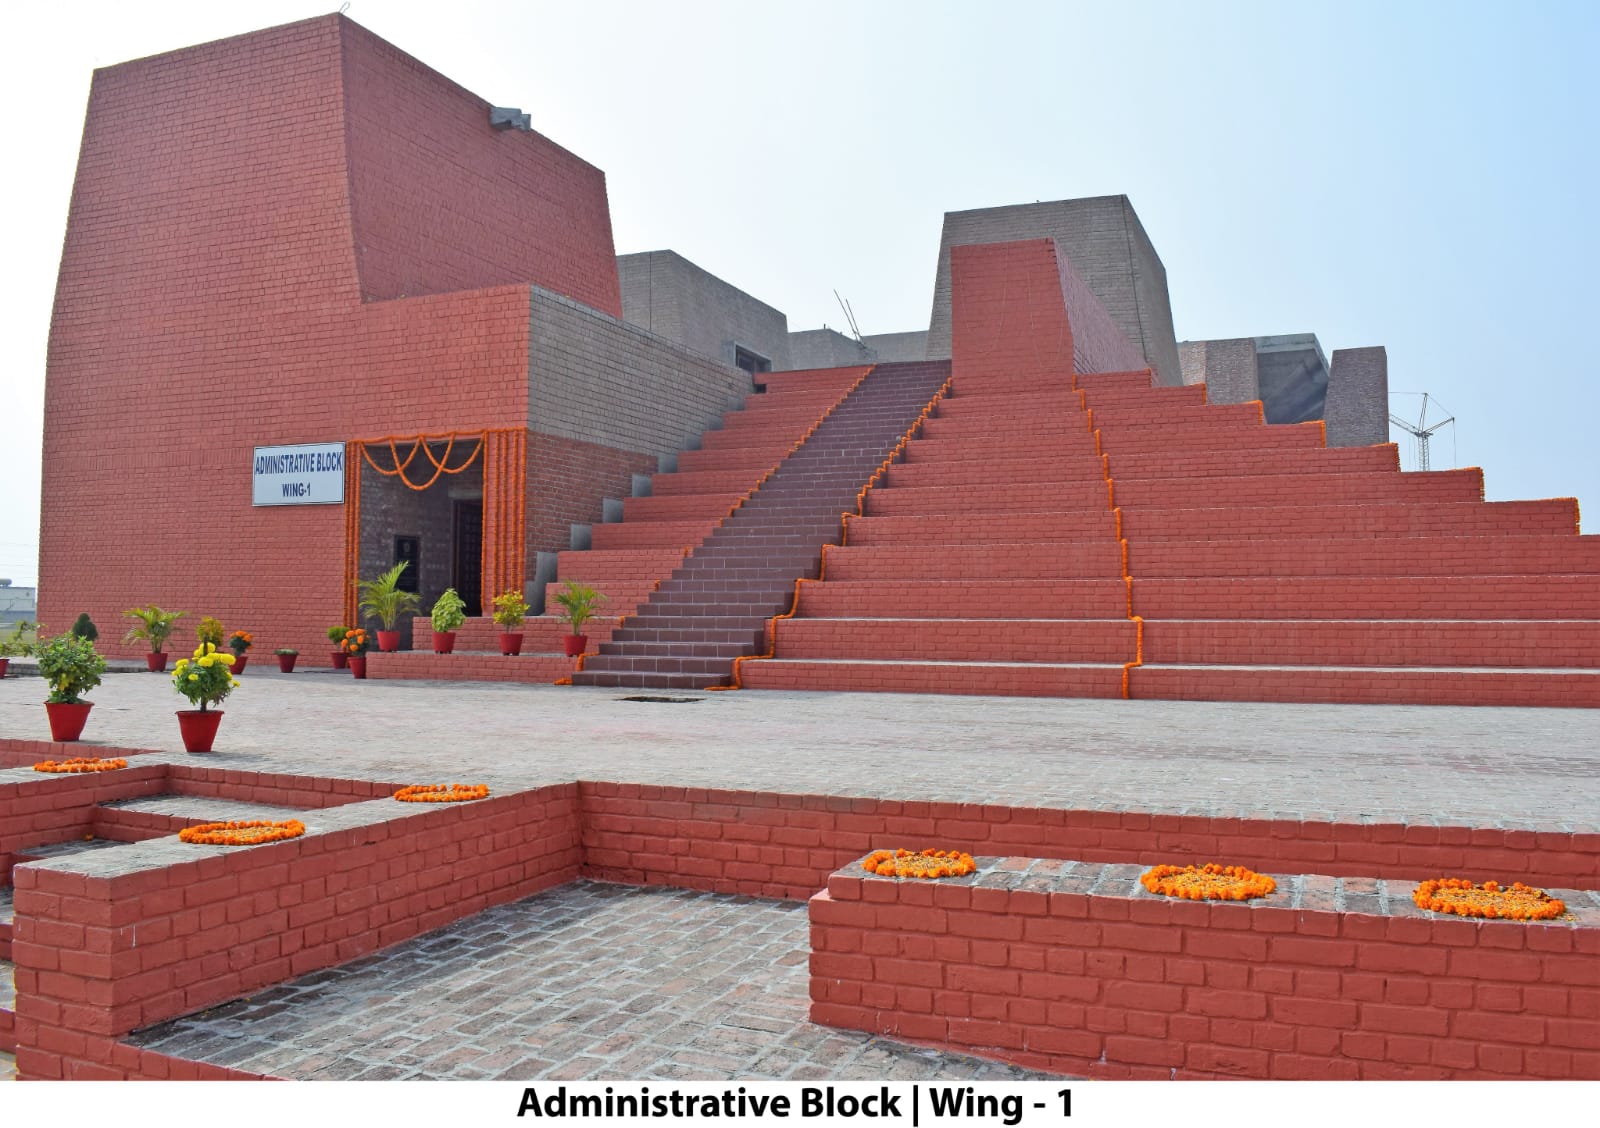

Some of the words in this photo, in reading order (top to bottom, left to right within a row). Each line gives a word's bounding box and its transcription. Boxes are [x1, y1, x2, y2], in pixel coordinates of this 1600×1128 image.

[255, 453, 315, 475] ADMINISTRATIVE
[316, 451, 343, 472] BLOCK
[282, 482, 311, 497] WING-1
